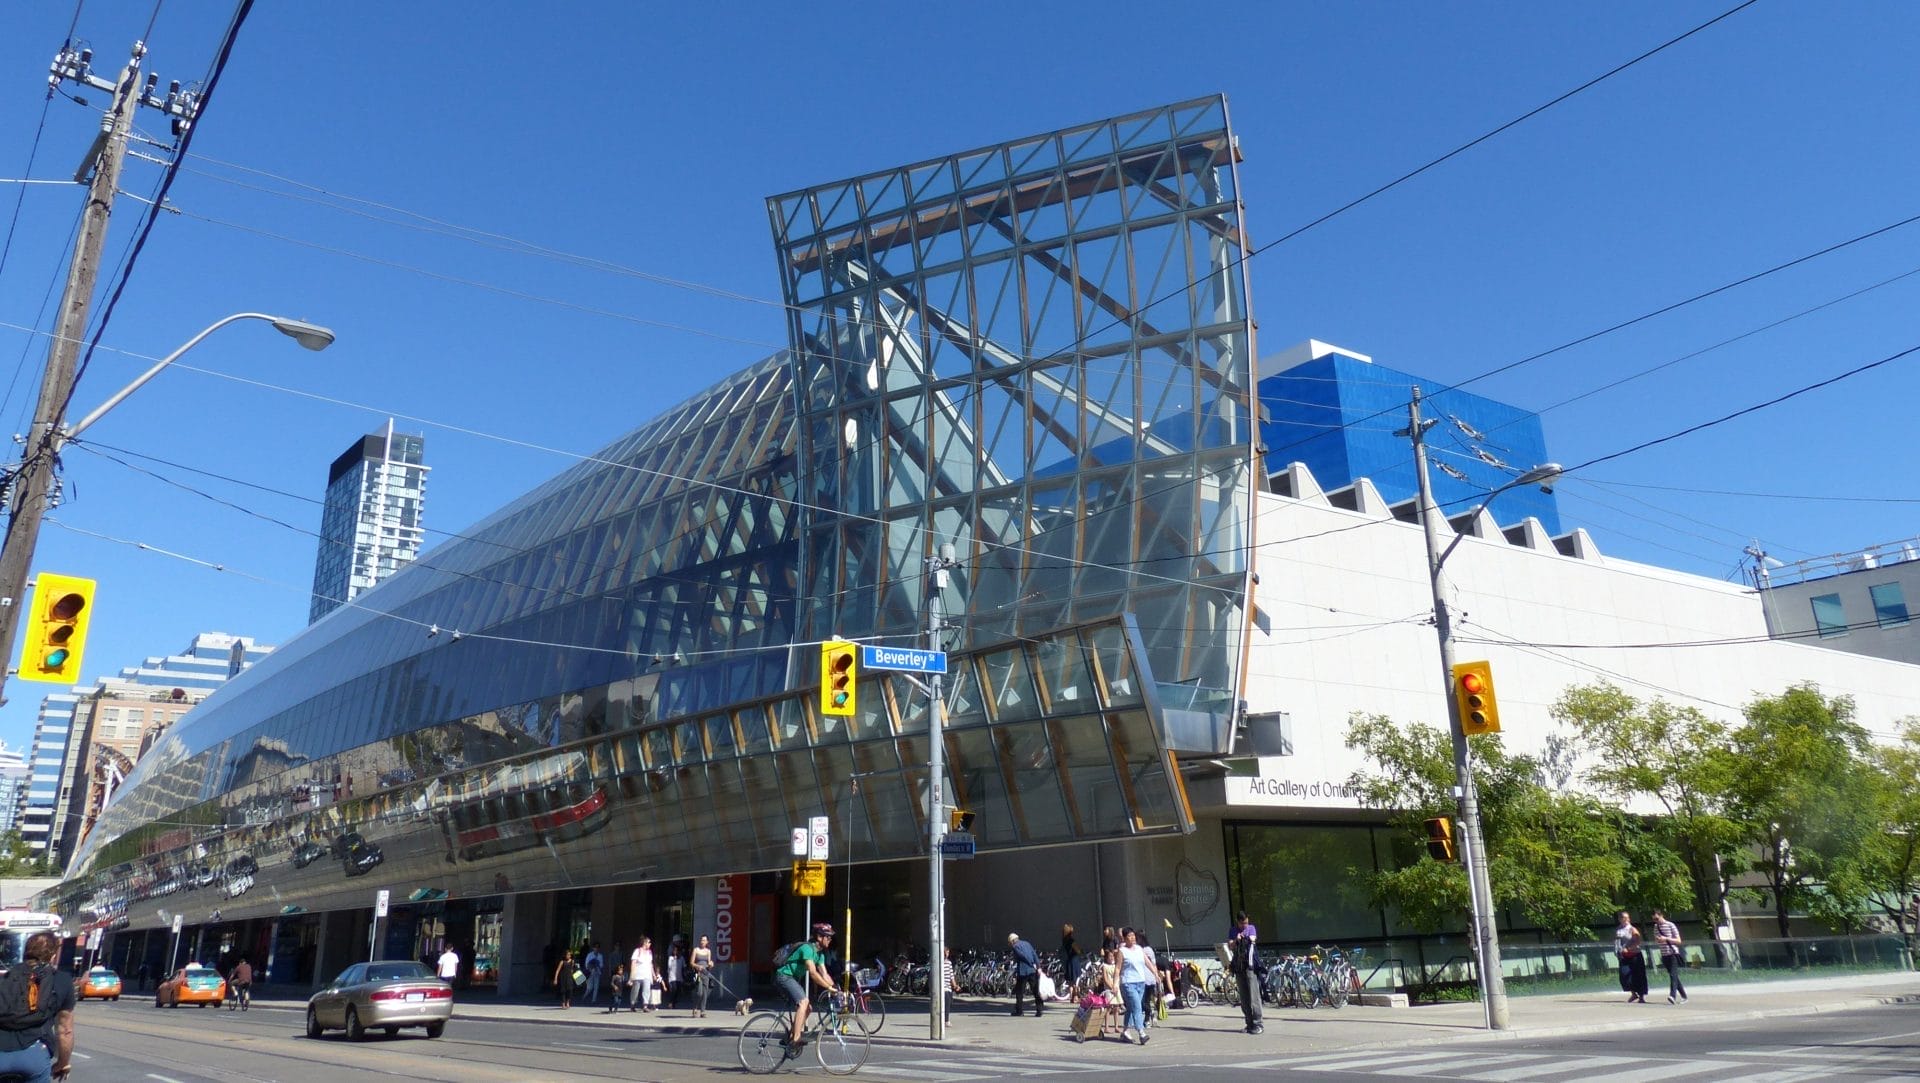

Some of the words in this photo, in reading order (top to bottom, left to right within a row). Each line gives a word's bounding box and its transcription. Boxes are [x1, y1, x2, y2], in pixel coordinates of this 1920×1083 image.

[875, 649, 928, 669] Beverley
[1250, 777, 1266, 794] Art
[1267, 779, 1308, 799] Gallery
[1310, 781, 1321, 797] of
[1180, 884, 1214, 896] learning
